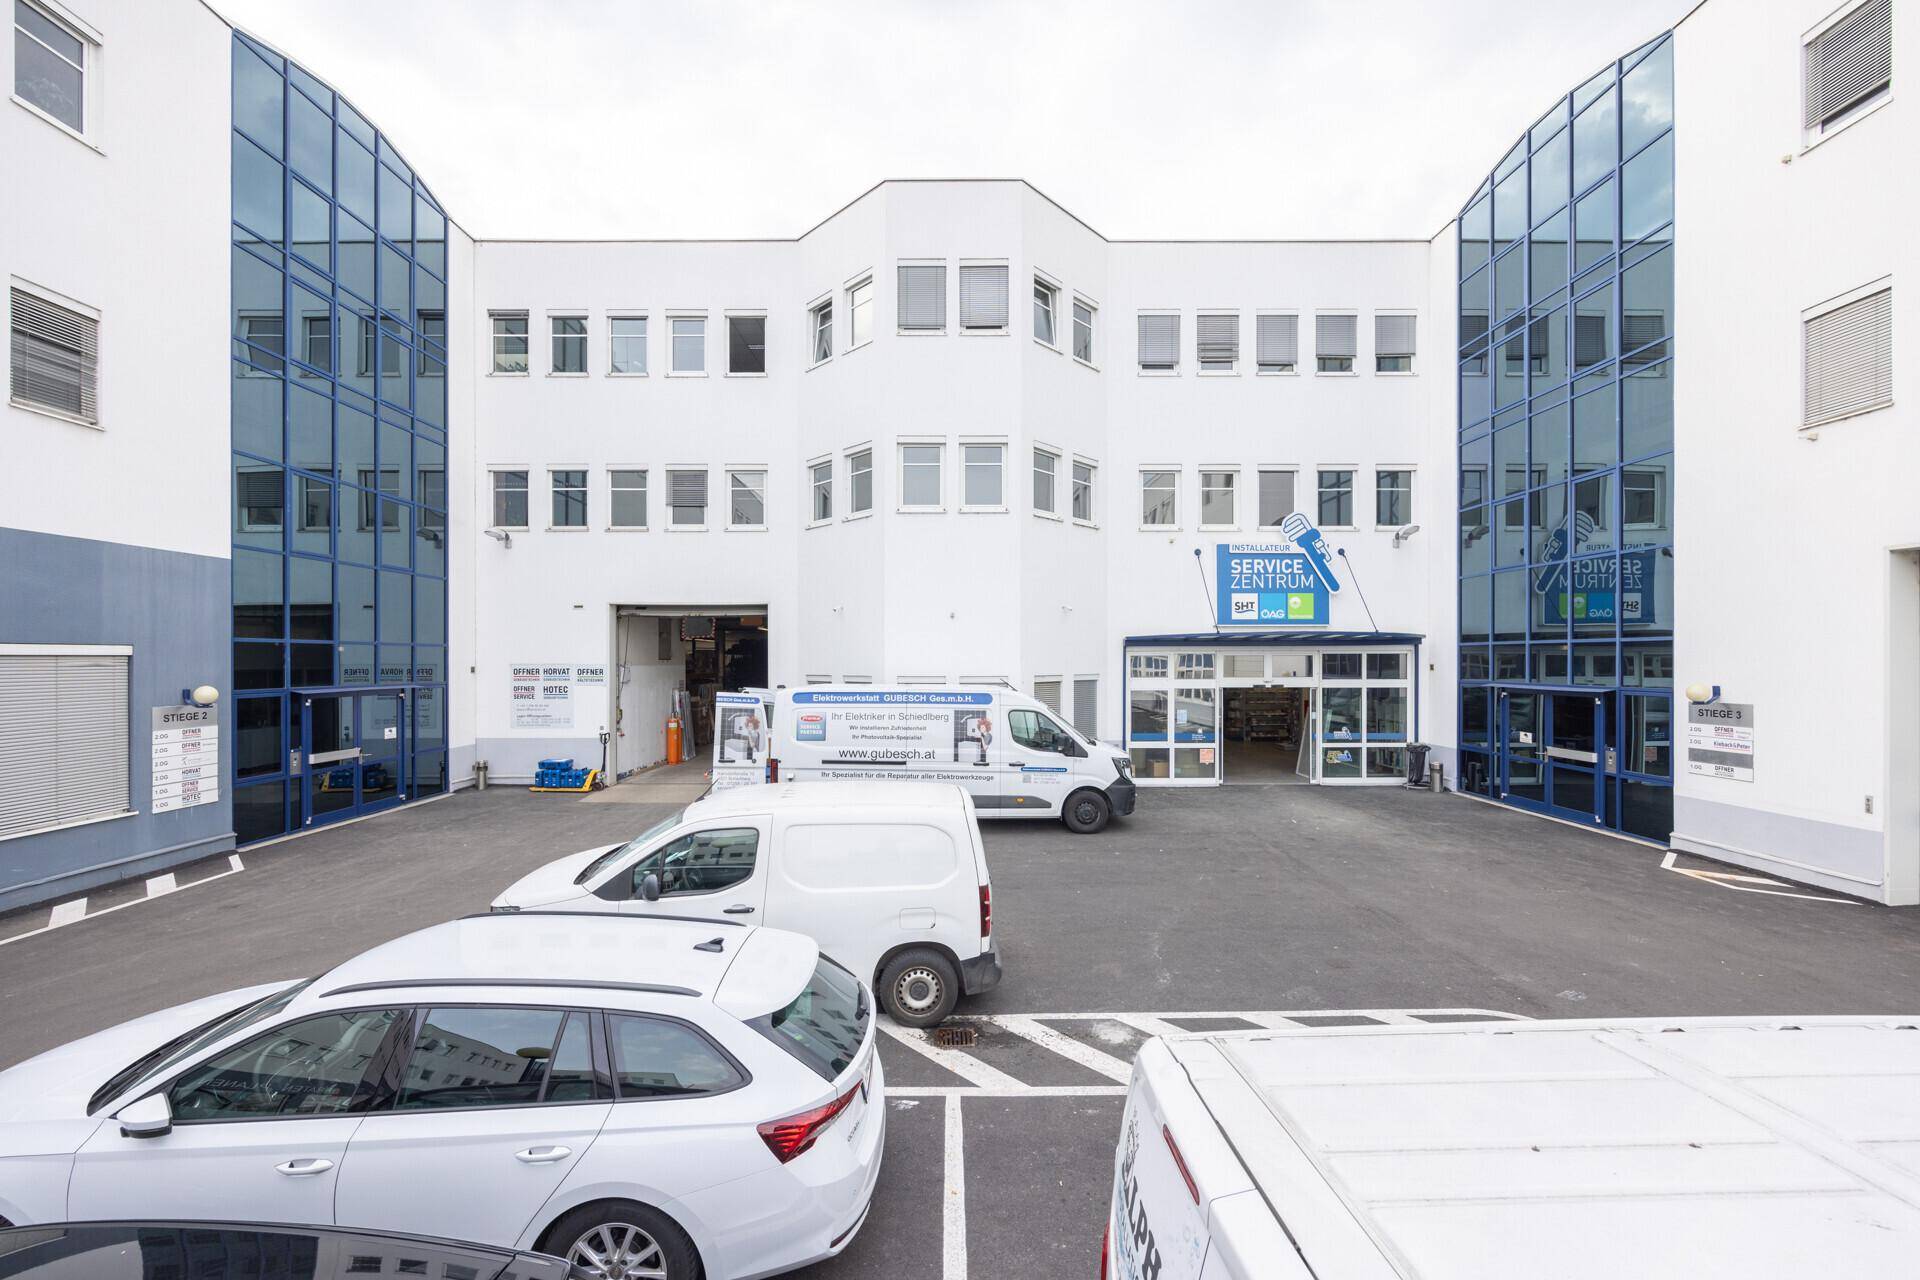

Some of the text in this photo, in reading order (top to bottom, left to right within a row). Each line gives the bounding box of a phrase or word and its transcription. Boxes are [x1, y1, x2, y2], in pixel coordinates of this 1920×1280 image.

[1230, 559, 1304, 574] SERVICE
[1230, 574, 1314, 588] ZENTRUM
[1234, 601, 1255, 611] SHT
[163, 712, 208, 723] STIEGE 2
[898, 713, 949, 722] Schiedlberg
[1698, 709, 1742, 719] STIEGE 3
[839, 749, 936, 761] www.gubesch.at
